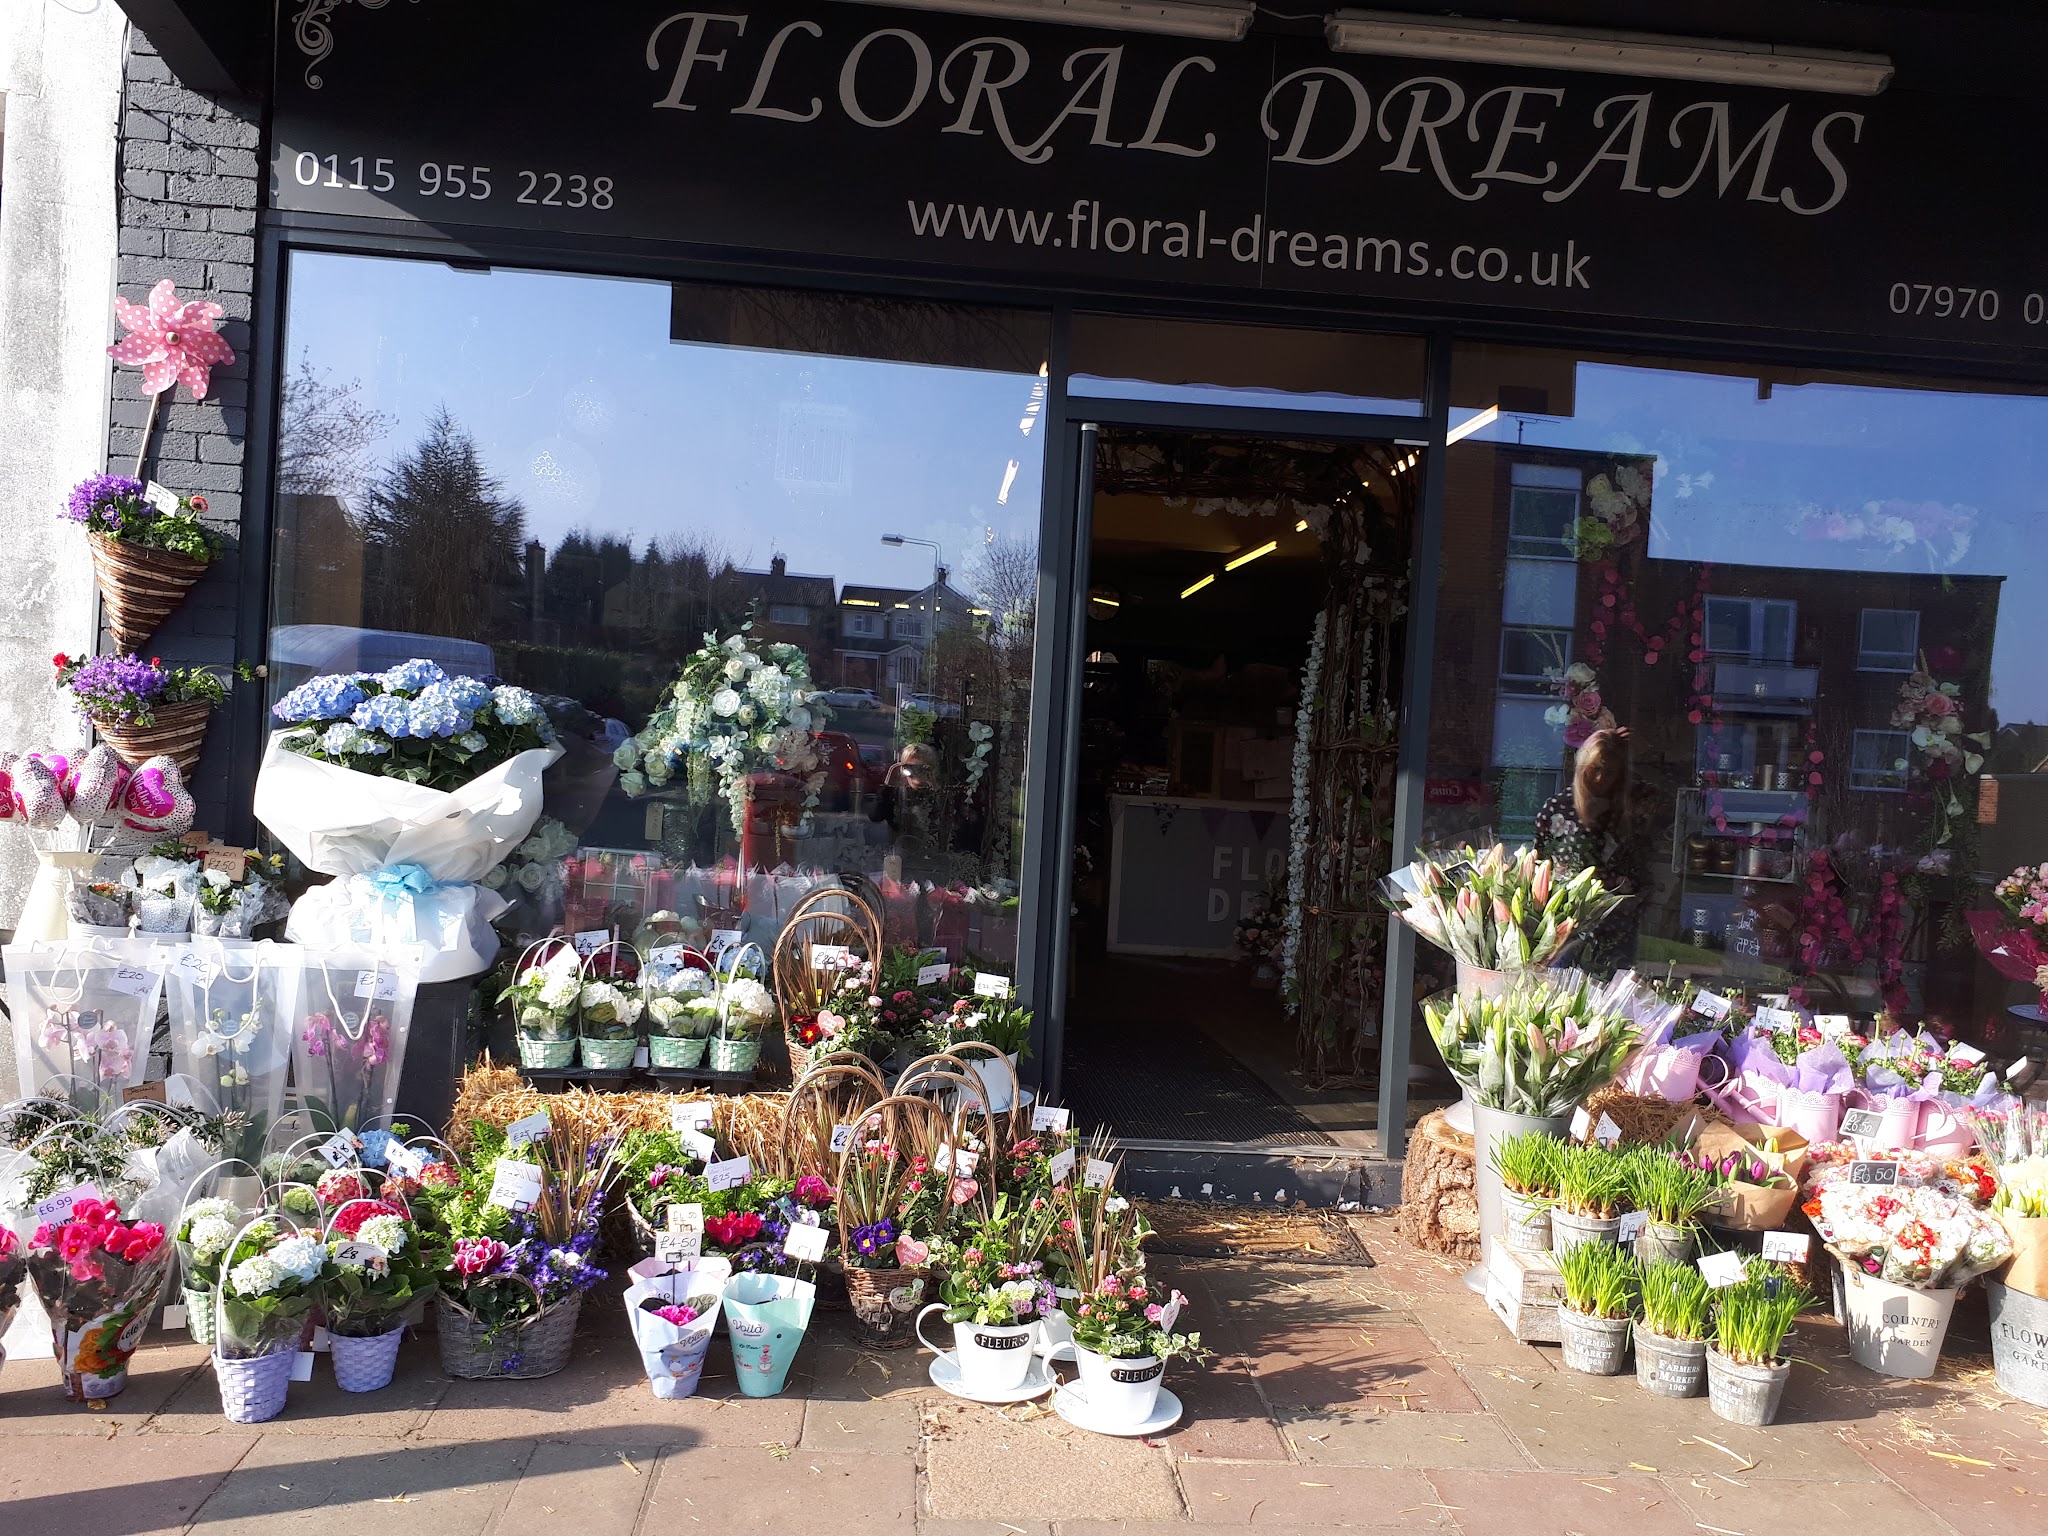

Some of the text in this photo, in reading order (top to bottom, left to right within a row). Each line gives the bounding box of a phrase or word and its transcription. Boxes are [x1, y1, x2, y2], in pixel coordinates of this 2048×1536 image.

[646, 12, 1864, 215] FLORAL DREAMS
[294, 152, 614, 210] 0115 955 2238
[908, 200, 1591, 289] www.floral-dreams.co.uk
[1889, 282, 2048, 325] 07970 0
[149, 773, 166, 807] Happy
[127, 791, 142, 812] Day
[118, 967, 144, 980] £20
[39, 1196, 73, 1216] £6.99
[338, 1246, 360, 1260] £8
[1882, 1313, 1942, 1329] COUNTRY
[980, 1334, 1025, 1349] FLEURS
[1889, 1335, 1932, 1347] GARDEN
[1658, 1359, 1700, 1373] FARMERS
[1658, 1371, 1697, 1384] MARKET
[1668, 1383, 1687, 1392] 1968
